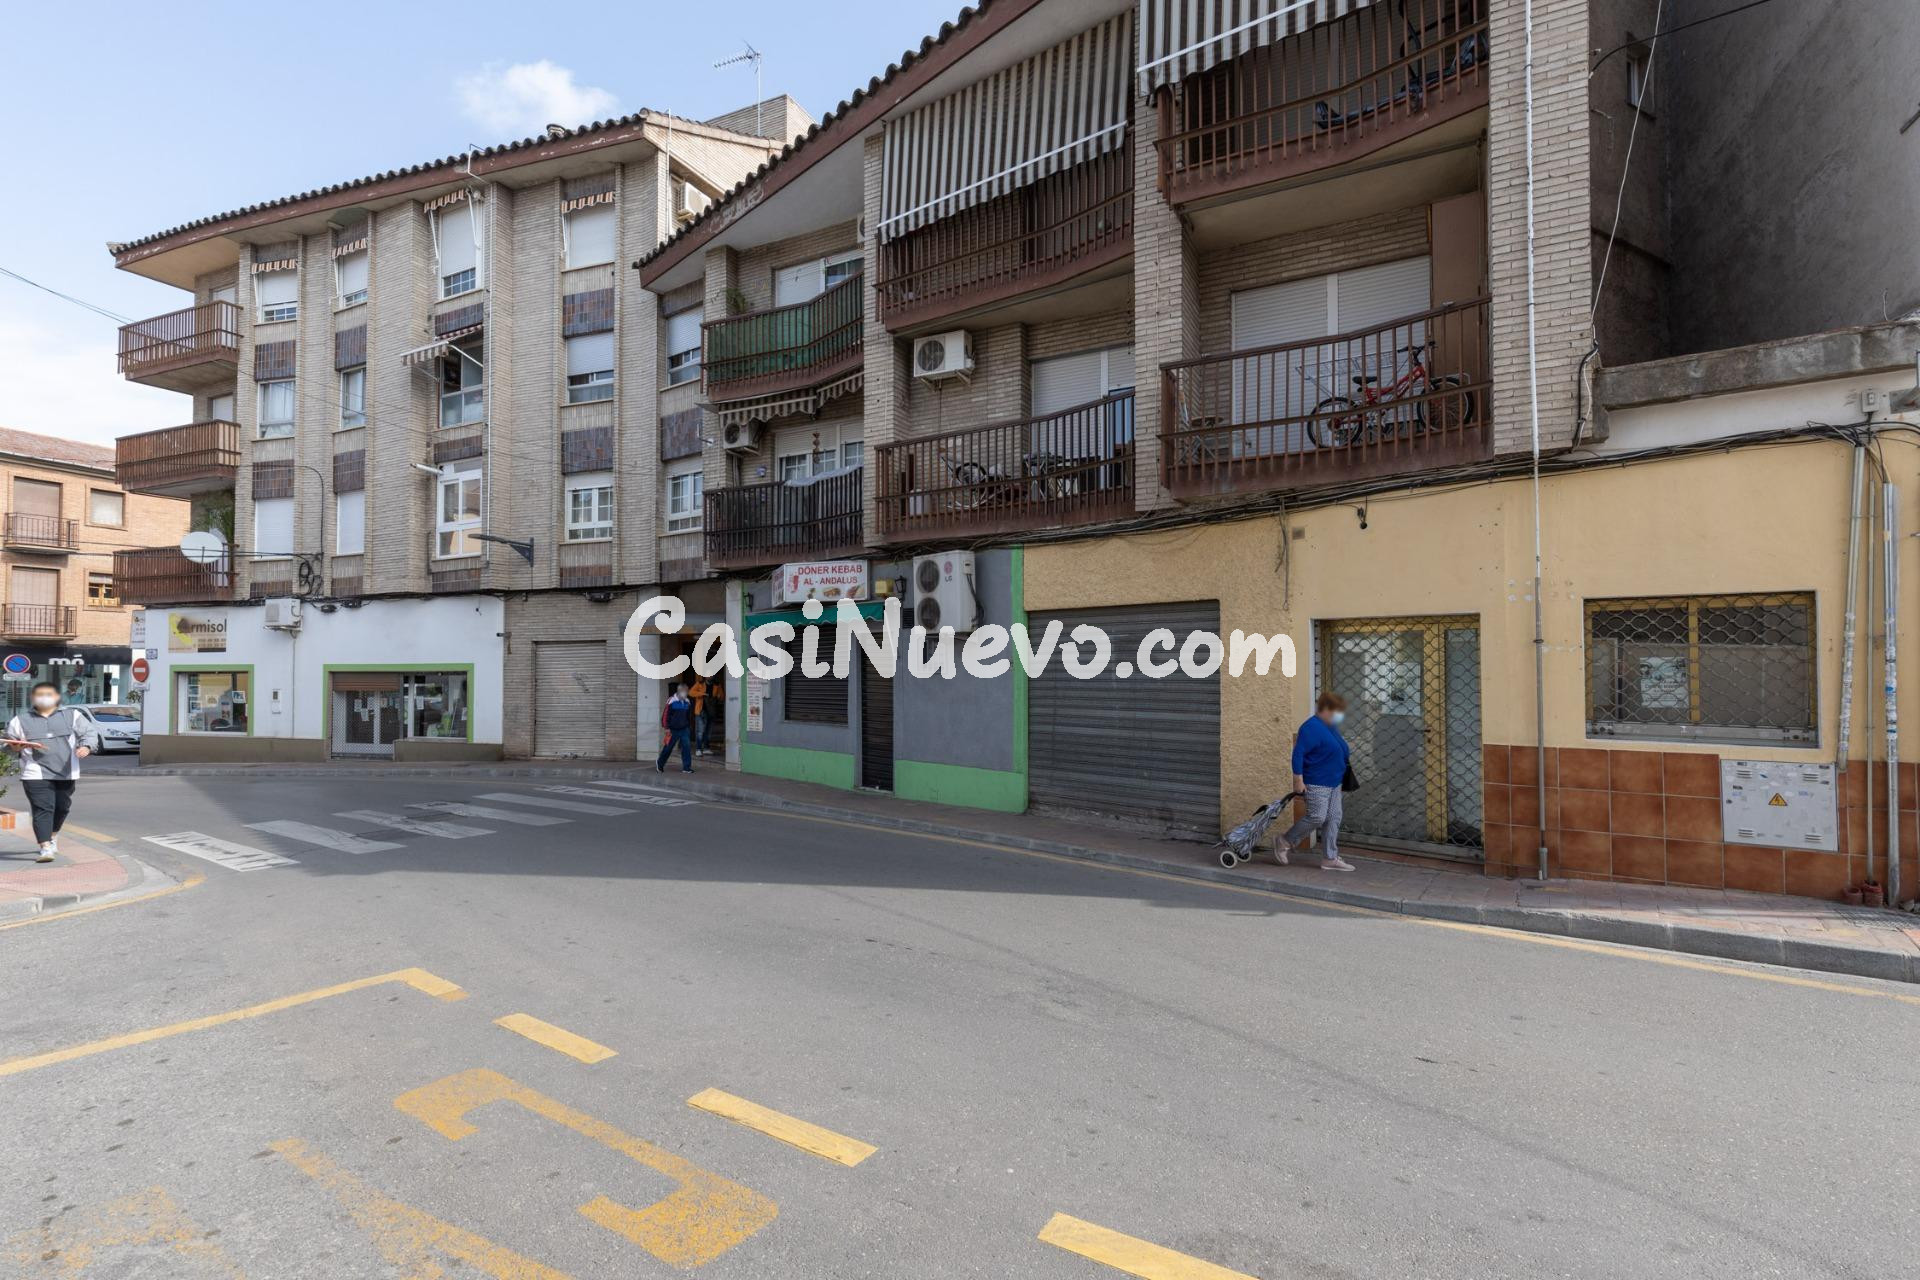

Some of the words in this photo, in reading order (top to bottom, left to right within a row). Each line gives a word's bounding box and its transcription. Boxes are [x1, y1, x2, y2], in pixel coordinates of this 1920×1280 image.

[832, 565, 862, 574] KEBAB
[820, 576, 858, 585] ANDALUS
[945, 575, 953, 583] LG
